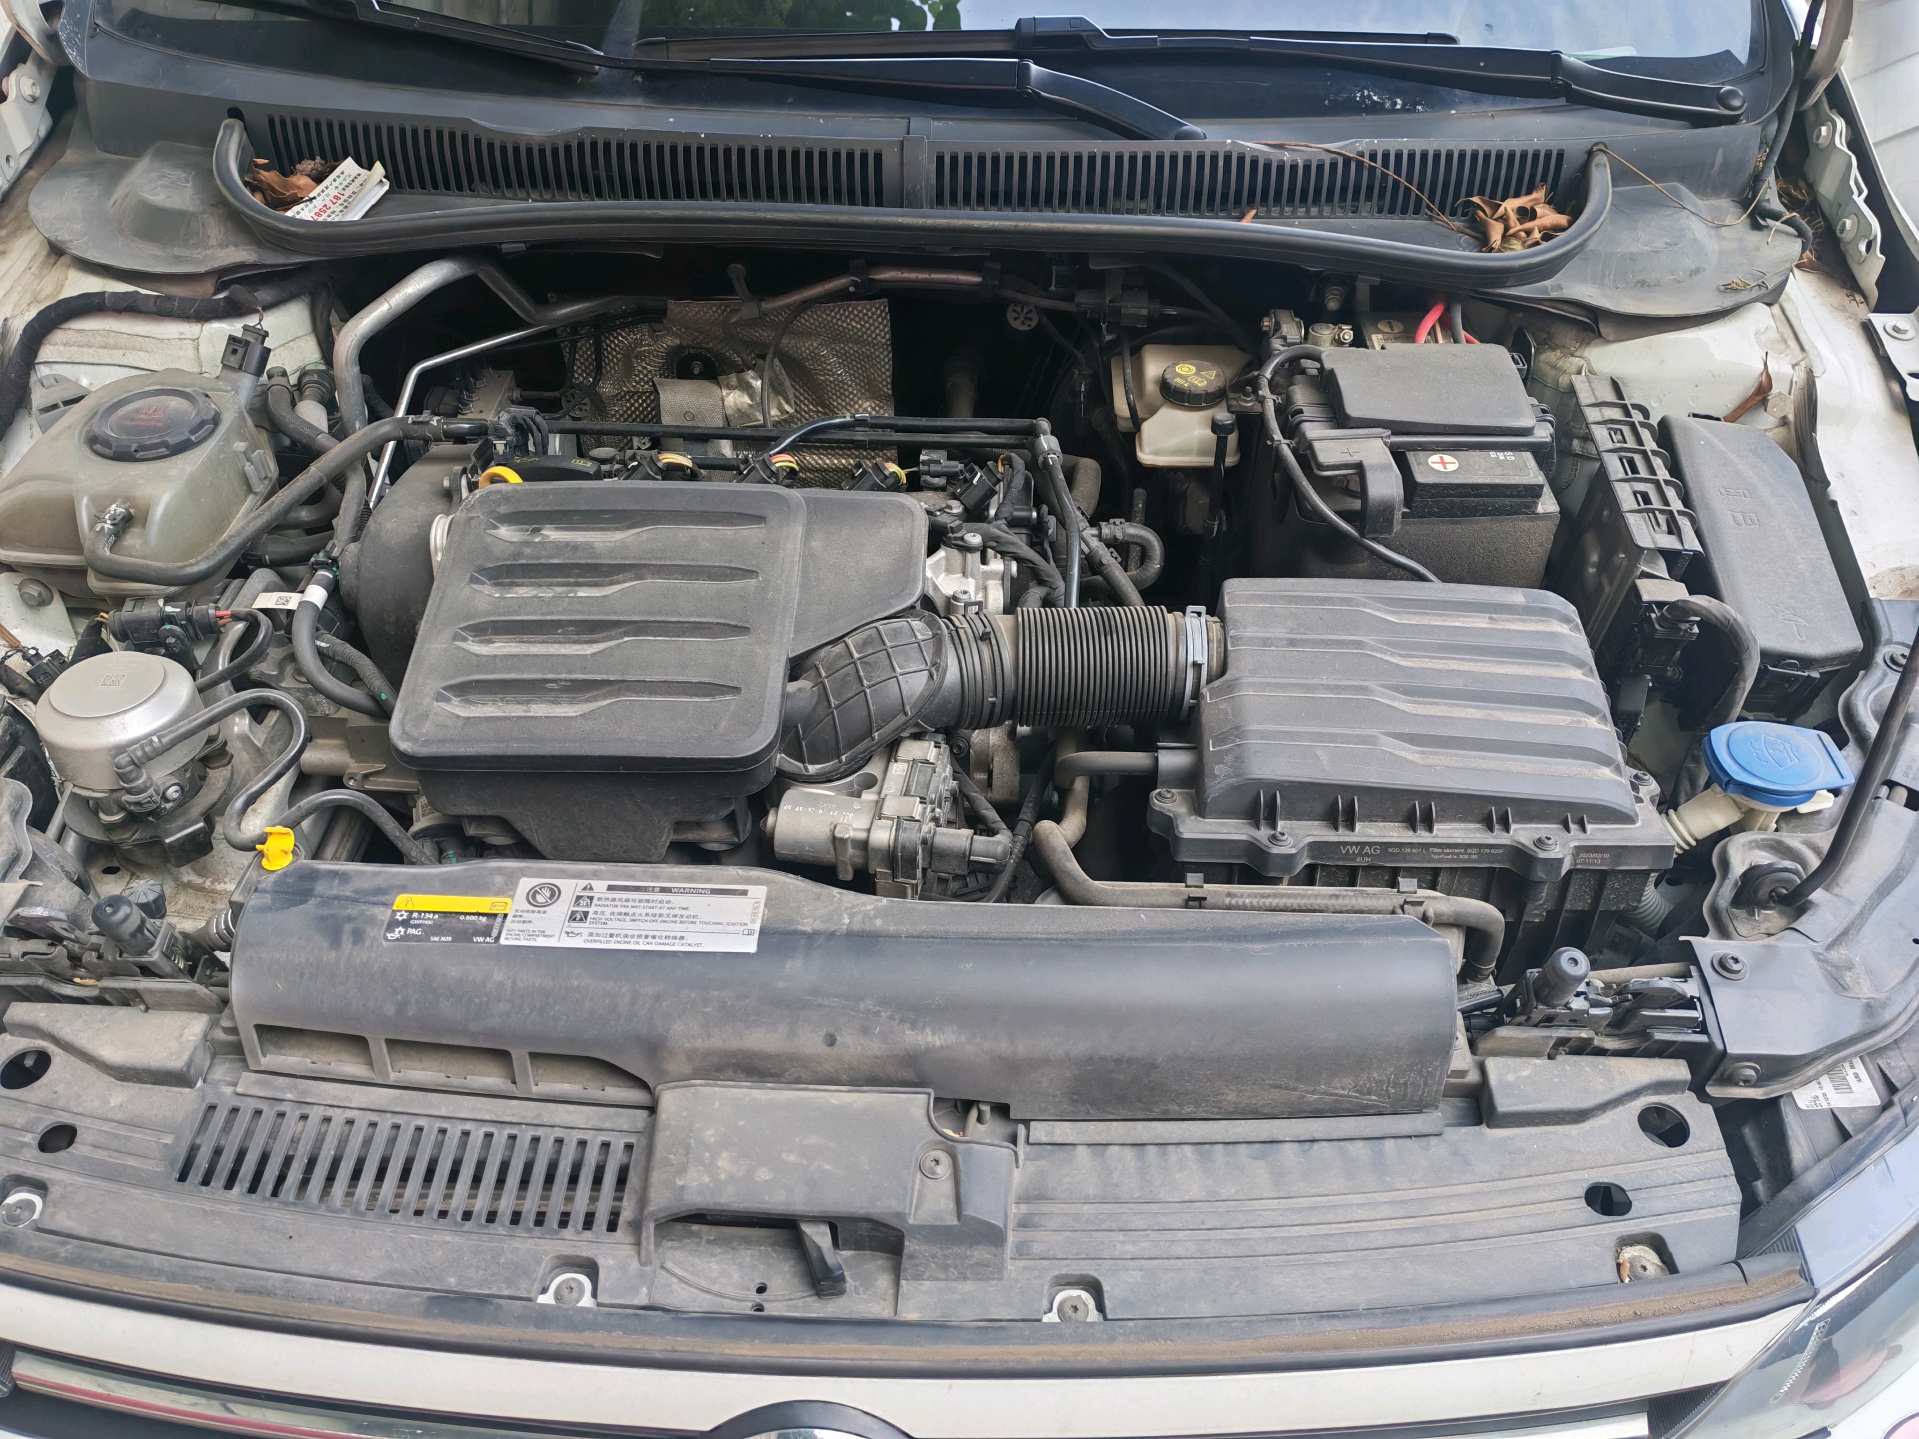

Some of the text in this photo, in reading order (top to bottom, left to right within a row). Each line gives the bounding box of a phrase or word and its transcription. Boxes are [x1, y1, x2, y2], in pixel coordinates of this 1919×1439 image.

[329, 191, 345, 206] 187
[1340, 845, 1381, 855] VW AG
[671, 886, 711, 895] WARNING
[472, 935, 495, 943] VW AG
